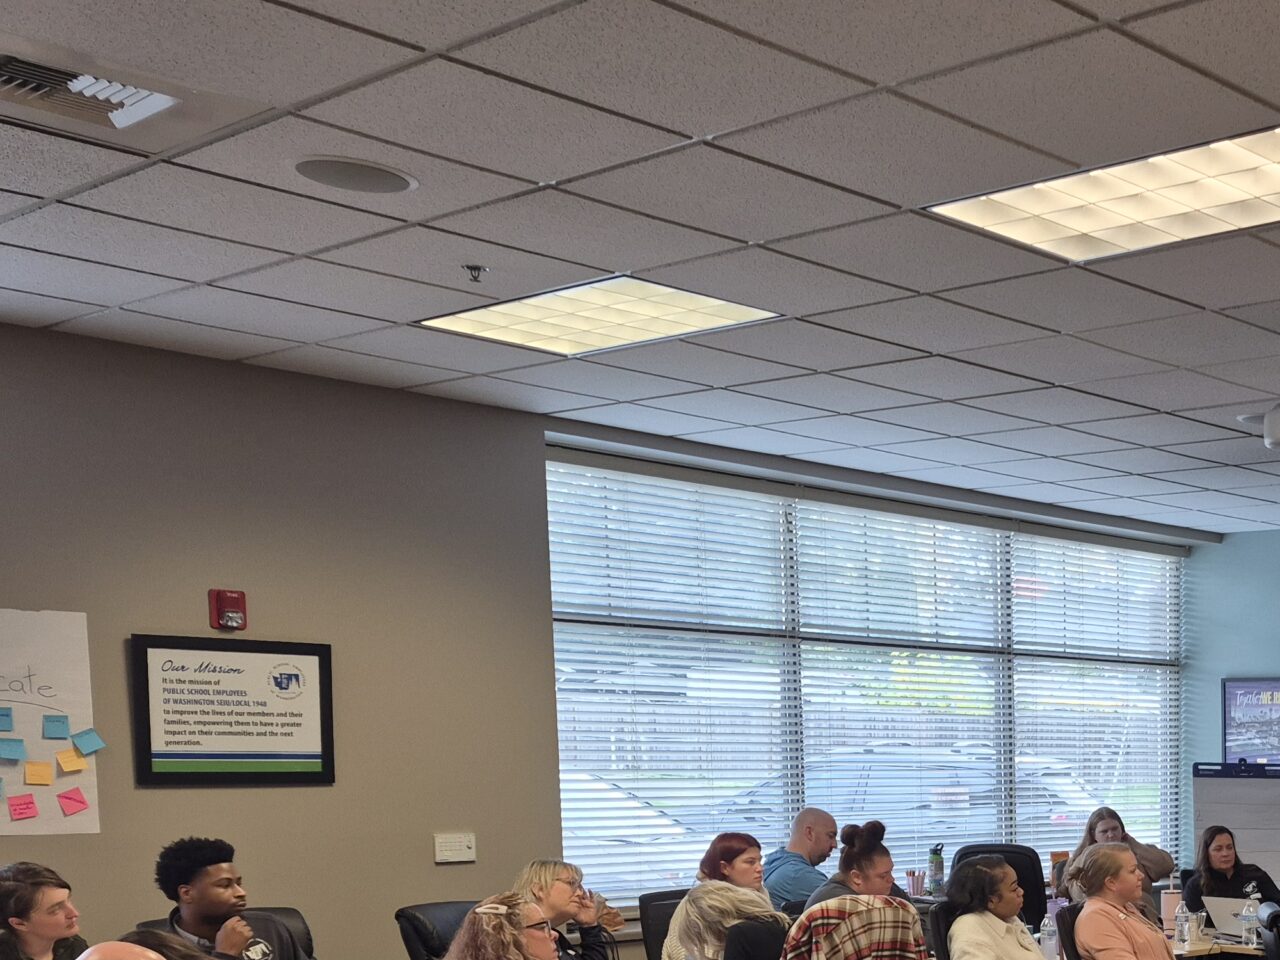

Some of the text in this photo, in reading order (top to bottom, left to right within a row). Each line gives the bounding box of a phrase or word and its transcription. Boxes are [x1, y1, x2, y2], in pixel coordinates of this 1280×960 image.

[161, 660, 245, 674] Our Mission
[163, 687, 247, 697] PUBLIC SCHOOL EMPLOYEES
[173, 698, 215, 706] WASHINGTON
[216, 699, 252, 708] SEIU/LOCAL
[172, 709, 198, 717] improve
[164, 719, 191, 727] families,
[193, 719, 233, 728] empowering
[280, 721, 302, 729] greater
[164, 729, 187, 737] impact
[164, 739, 203, 747] generation.
